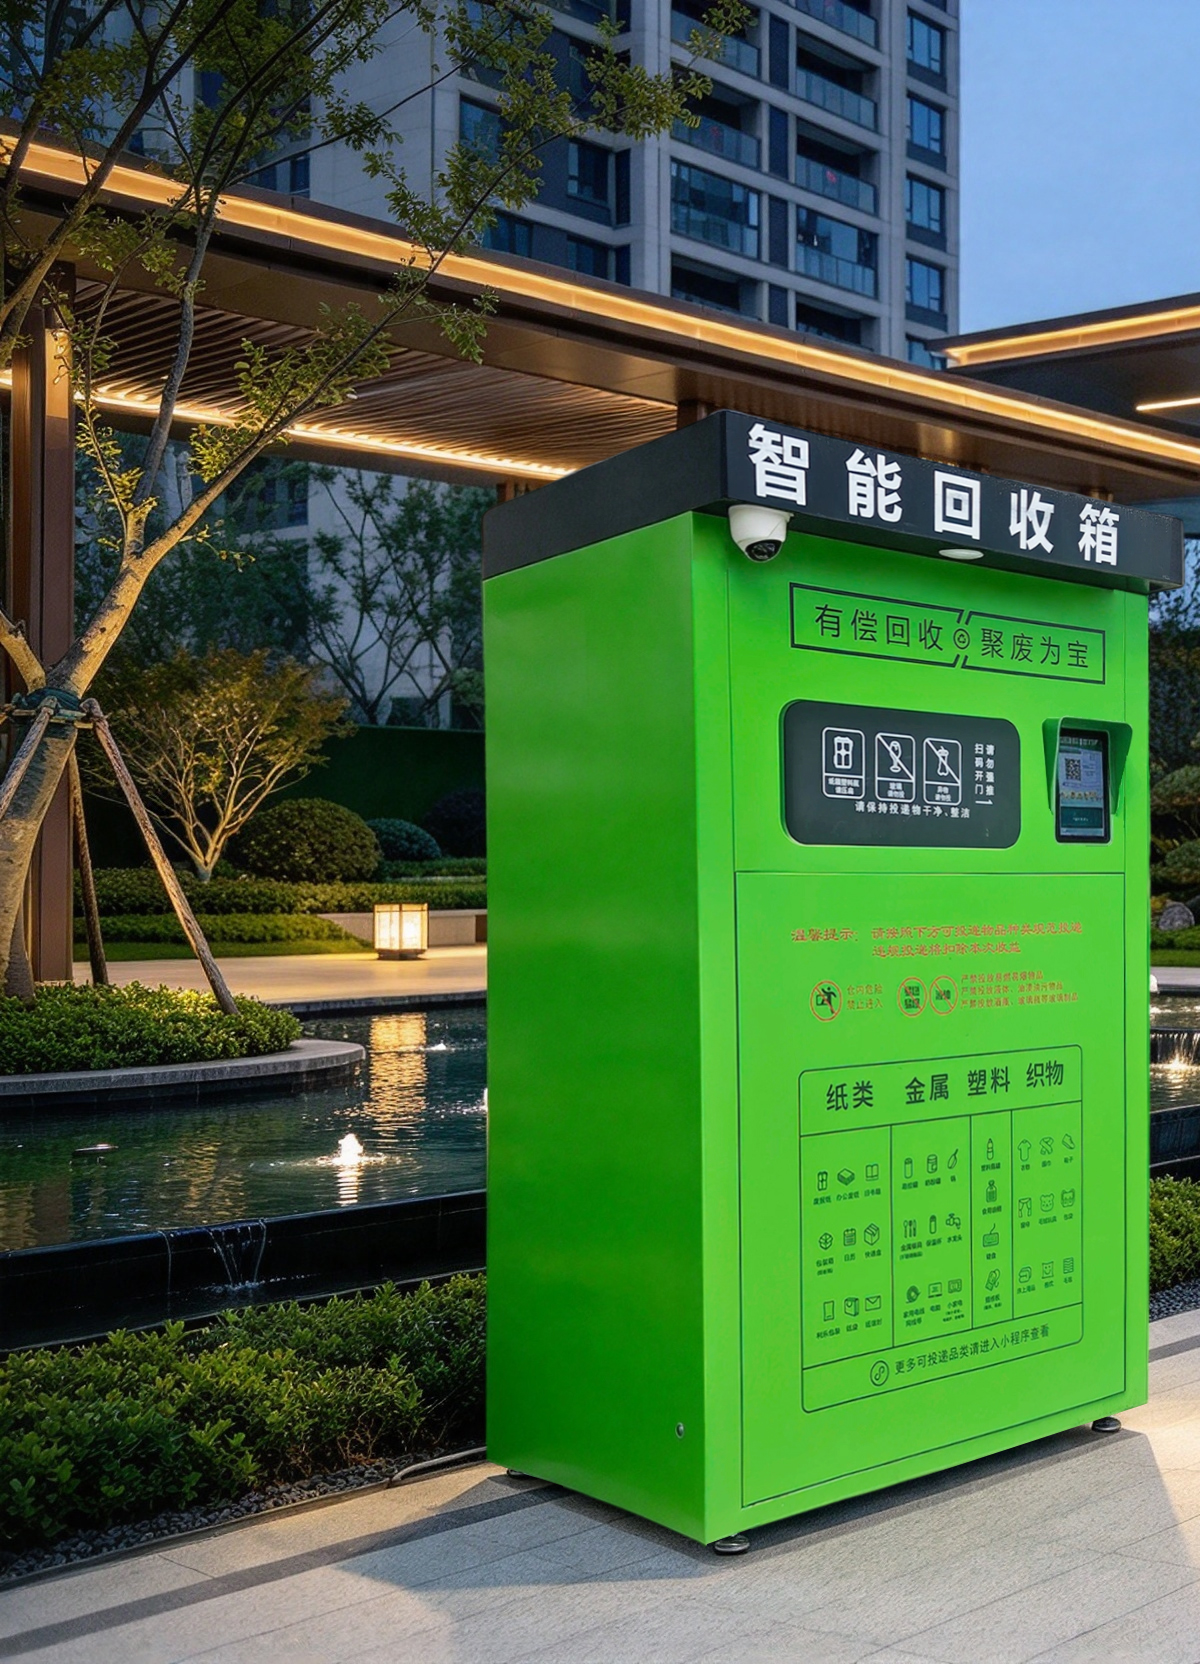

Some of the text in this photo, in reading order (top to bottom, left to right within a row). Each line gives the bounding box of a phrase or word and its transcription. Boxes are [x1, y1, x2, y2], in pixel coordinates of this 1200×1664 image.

[747, 423, 1120, 566] 智能回收箱
[814, 603, 1089, 669] 有偿回收 聚废为宝
[974, 743, 984, 795] 扫码开门
[985, 744, 995, 796] 请勿强推
[855, 801, 970, 818] 请保持投递物干净、整洁
[872, 941, 1021, 958] 违规投递将扣除本次收益
[847, 998, 883, 1010] 禁止进入
[826, 1059, 1064, 1112] 纸类 金属 塑料 织物
[895, 1323, 1050, 1375] 更多可投递品类请进入小程序查看
